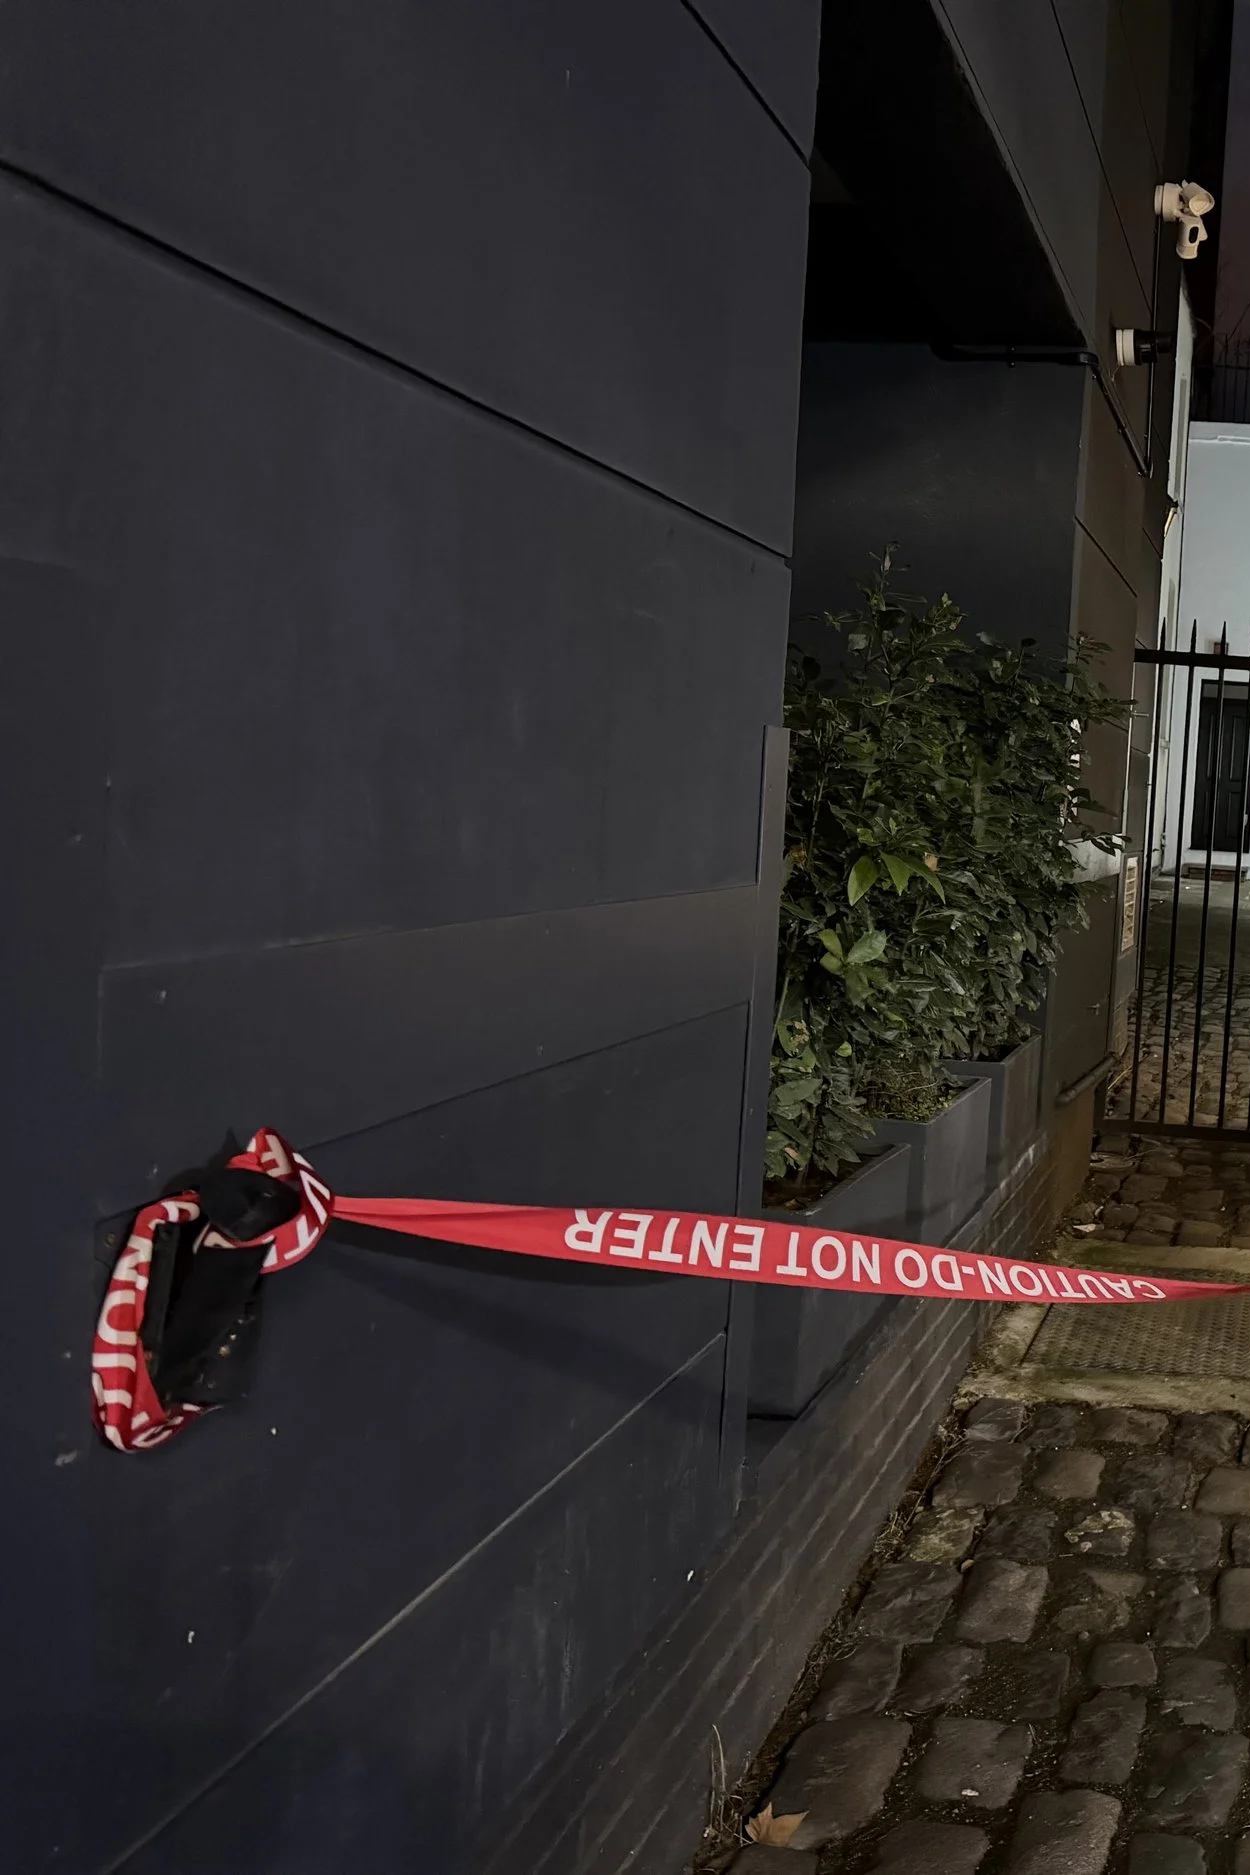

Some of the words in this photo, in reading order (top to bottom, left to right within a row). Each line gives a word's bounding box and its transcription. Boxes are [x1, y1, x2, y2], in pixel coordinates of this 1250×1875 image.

[565, 1208, 765, 1272] ENTER
[775, 1231, 882, 1285] NOT
[894, 1248, 1167, 1299] CAUTION-DO
